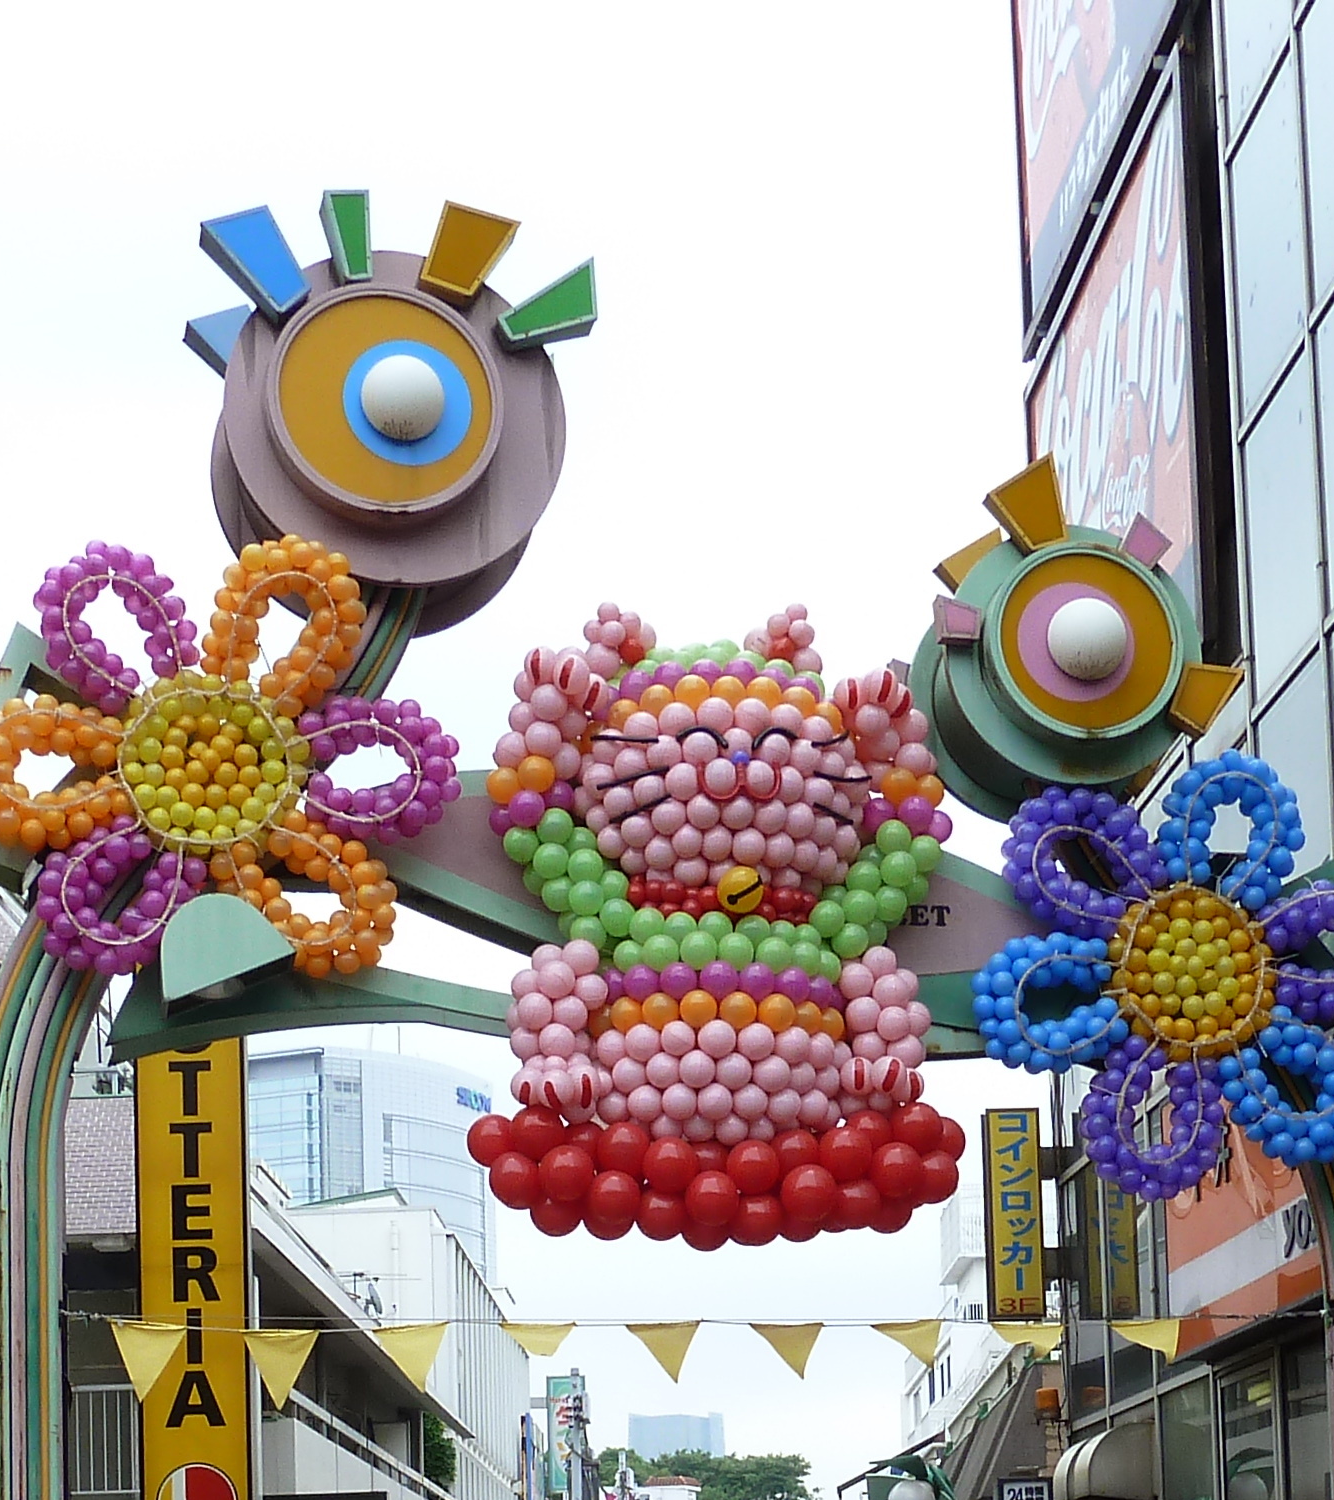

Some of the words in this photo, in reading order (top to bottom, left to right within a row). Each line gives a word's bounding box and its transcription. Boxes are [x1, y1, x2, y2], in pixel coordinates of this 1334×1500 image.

[166, 1043, 227, 1428] TTERIA
[995, 1113, 1037, 1292] コインロッカー
[999, 1297, 1041, 1313] 3F
